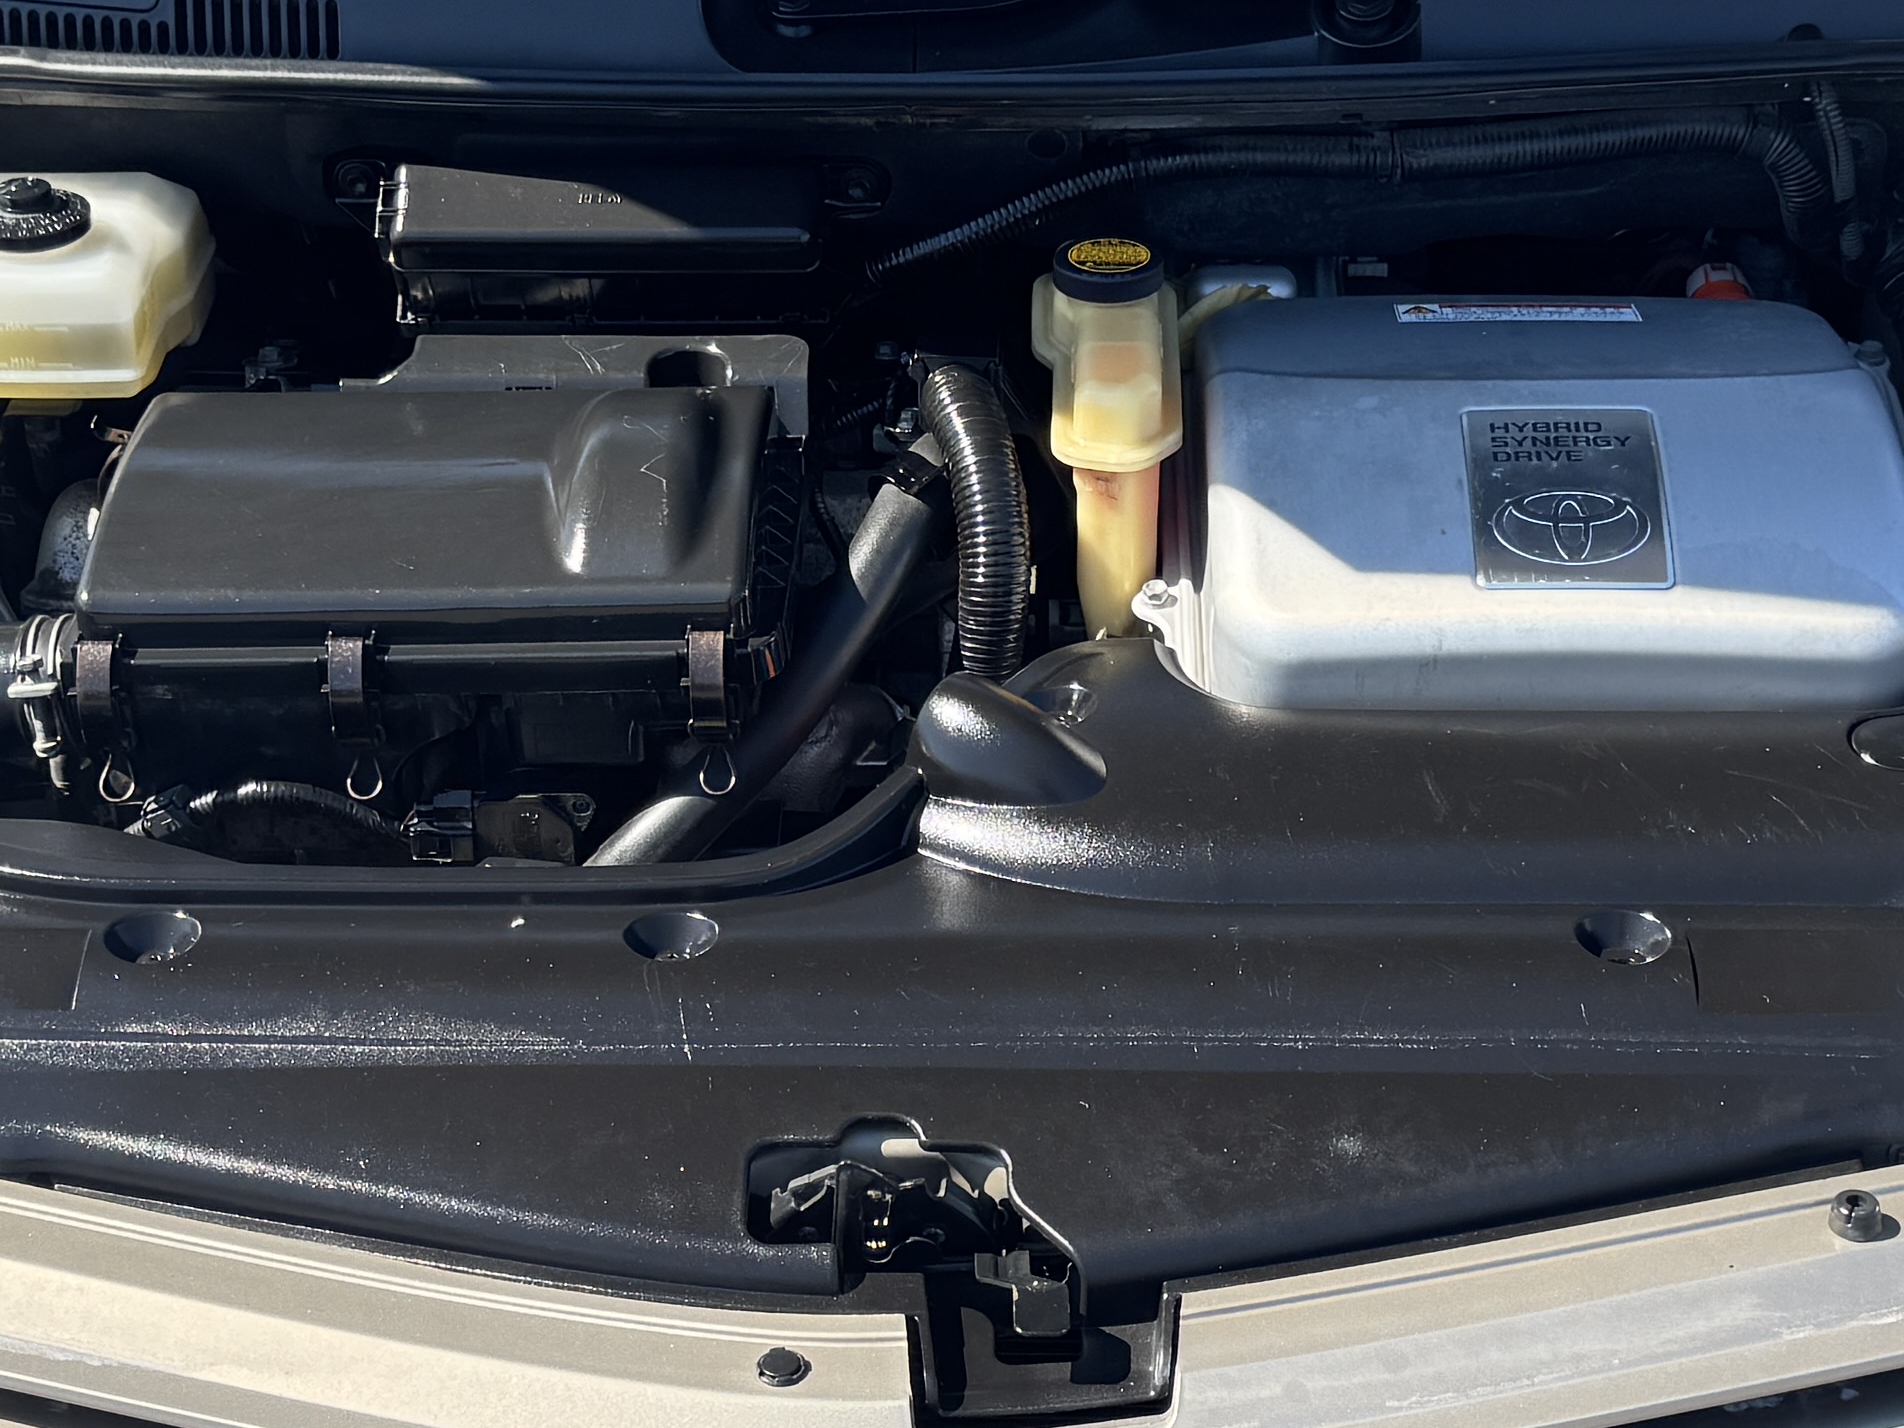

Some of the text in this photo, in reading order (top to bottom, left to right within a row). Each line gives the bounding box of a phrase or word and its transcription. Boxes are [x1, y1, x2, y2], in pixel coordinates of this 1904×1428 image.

[10, 357, 36, 368] MIN
[1489, 421, 1602, 434] HYBRID
[1490, 435, 1632, 448] SYNERGY
[1492, 450, 1585, 463] DRIVE
